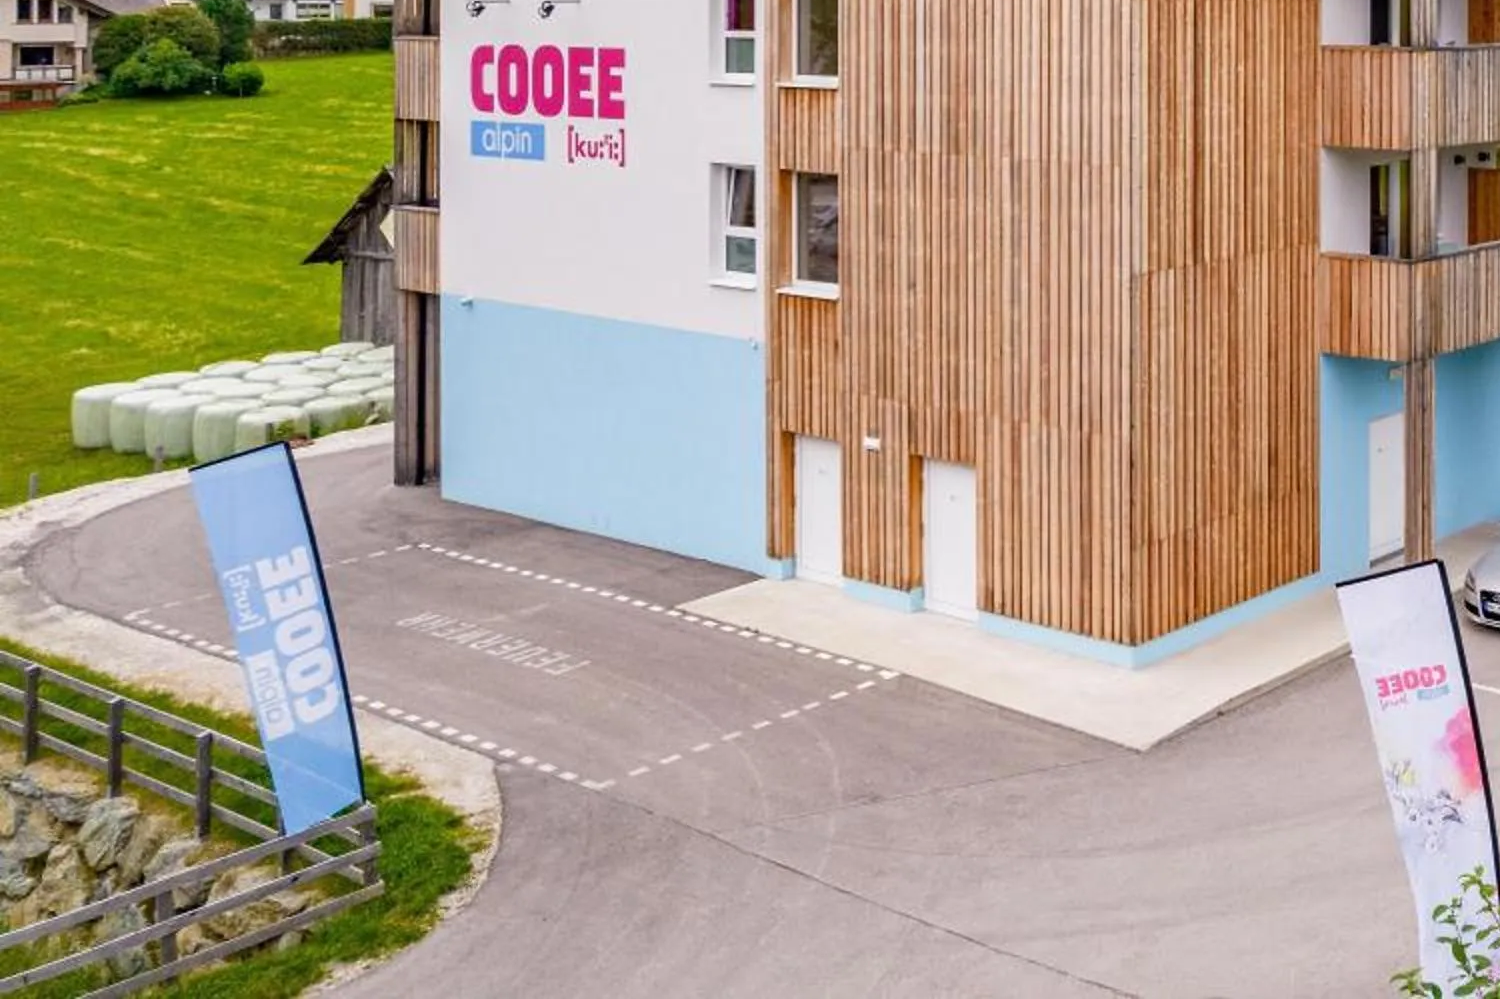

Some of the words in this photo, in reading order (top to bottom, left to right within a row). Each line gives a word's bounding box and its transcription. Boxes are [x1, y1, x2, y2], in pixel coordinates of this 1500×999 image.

[471, 44, 625, 119] COOEE
[482, 122, 532, 160] alpin
[395, 611, 592, 676] FEUERWEHR
